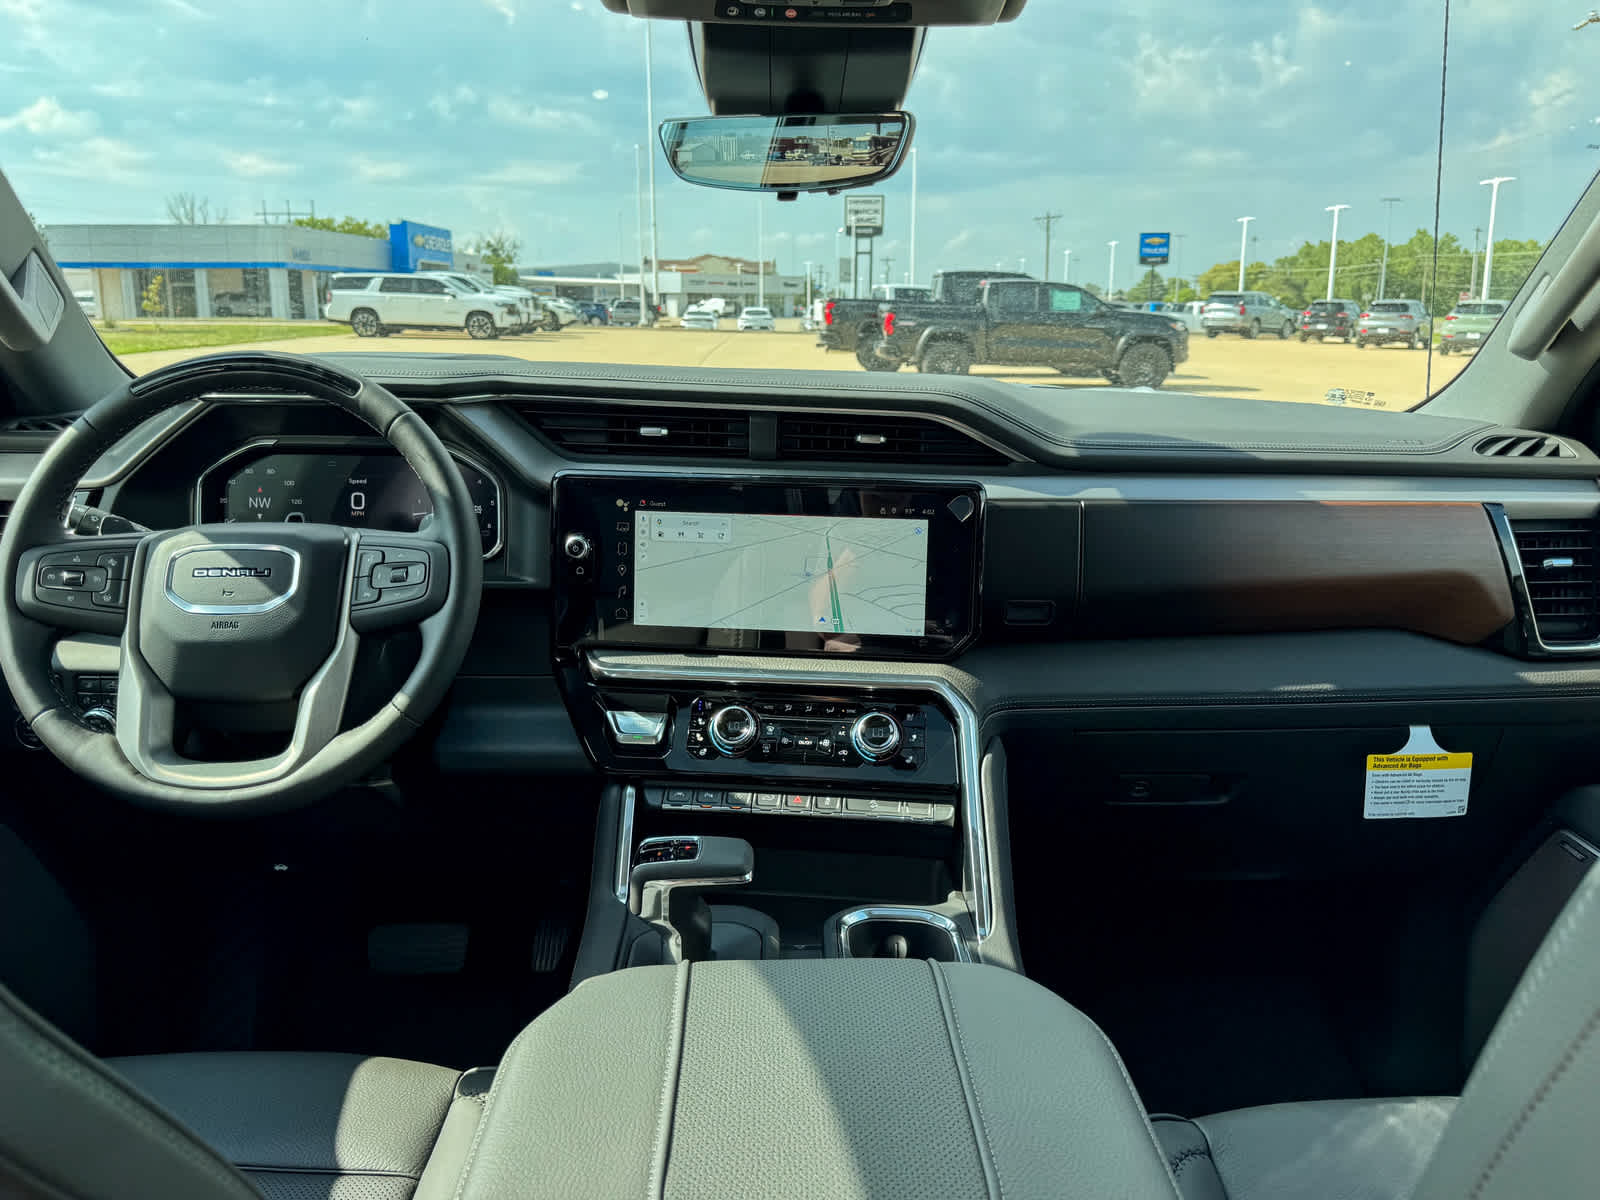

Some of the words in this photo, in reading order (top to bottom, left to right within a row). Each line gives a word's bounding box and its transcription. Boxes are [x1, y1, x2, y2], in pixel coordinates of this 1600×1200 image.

[248, 497, 272, 509] NW
[350, 492, 365, 510] 0
[192, 568, 271, 577] DENALI
[210, 621, 239, 629] AIRBAG
[1412, 755, 1436, 763] Equipped
